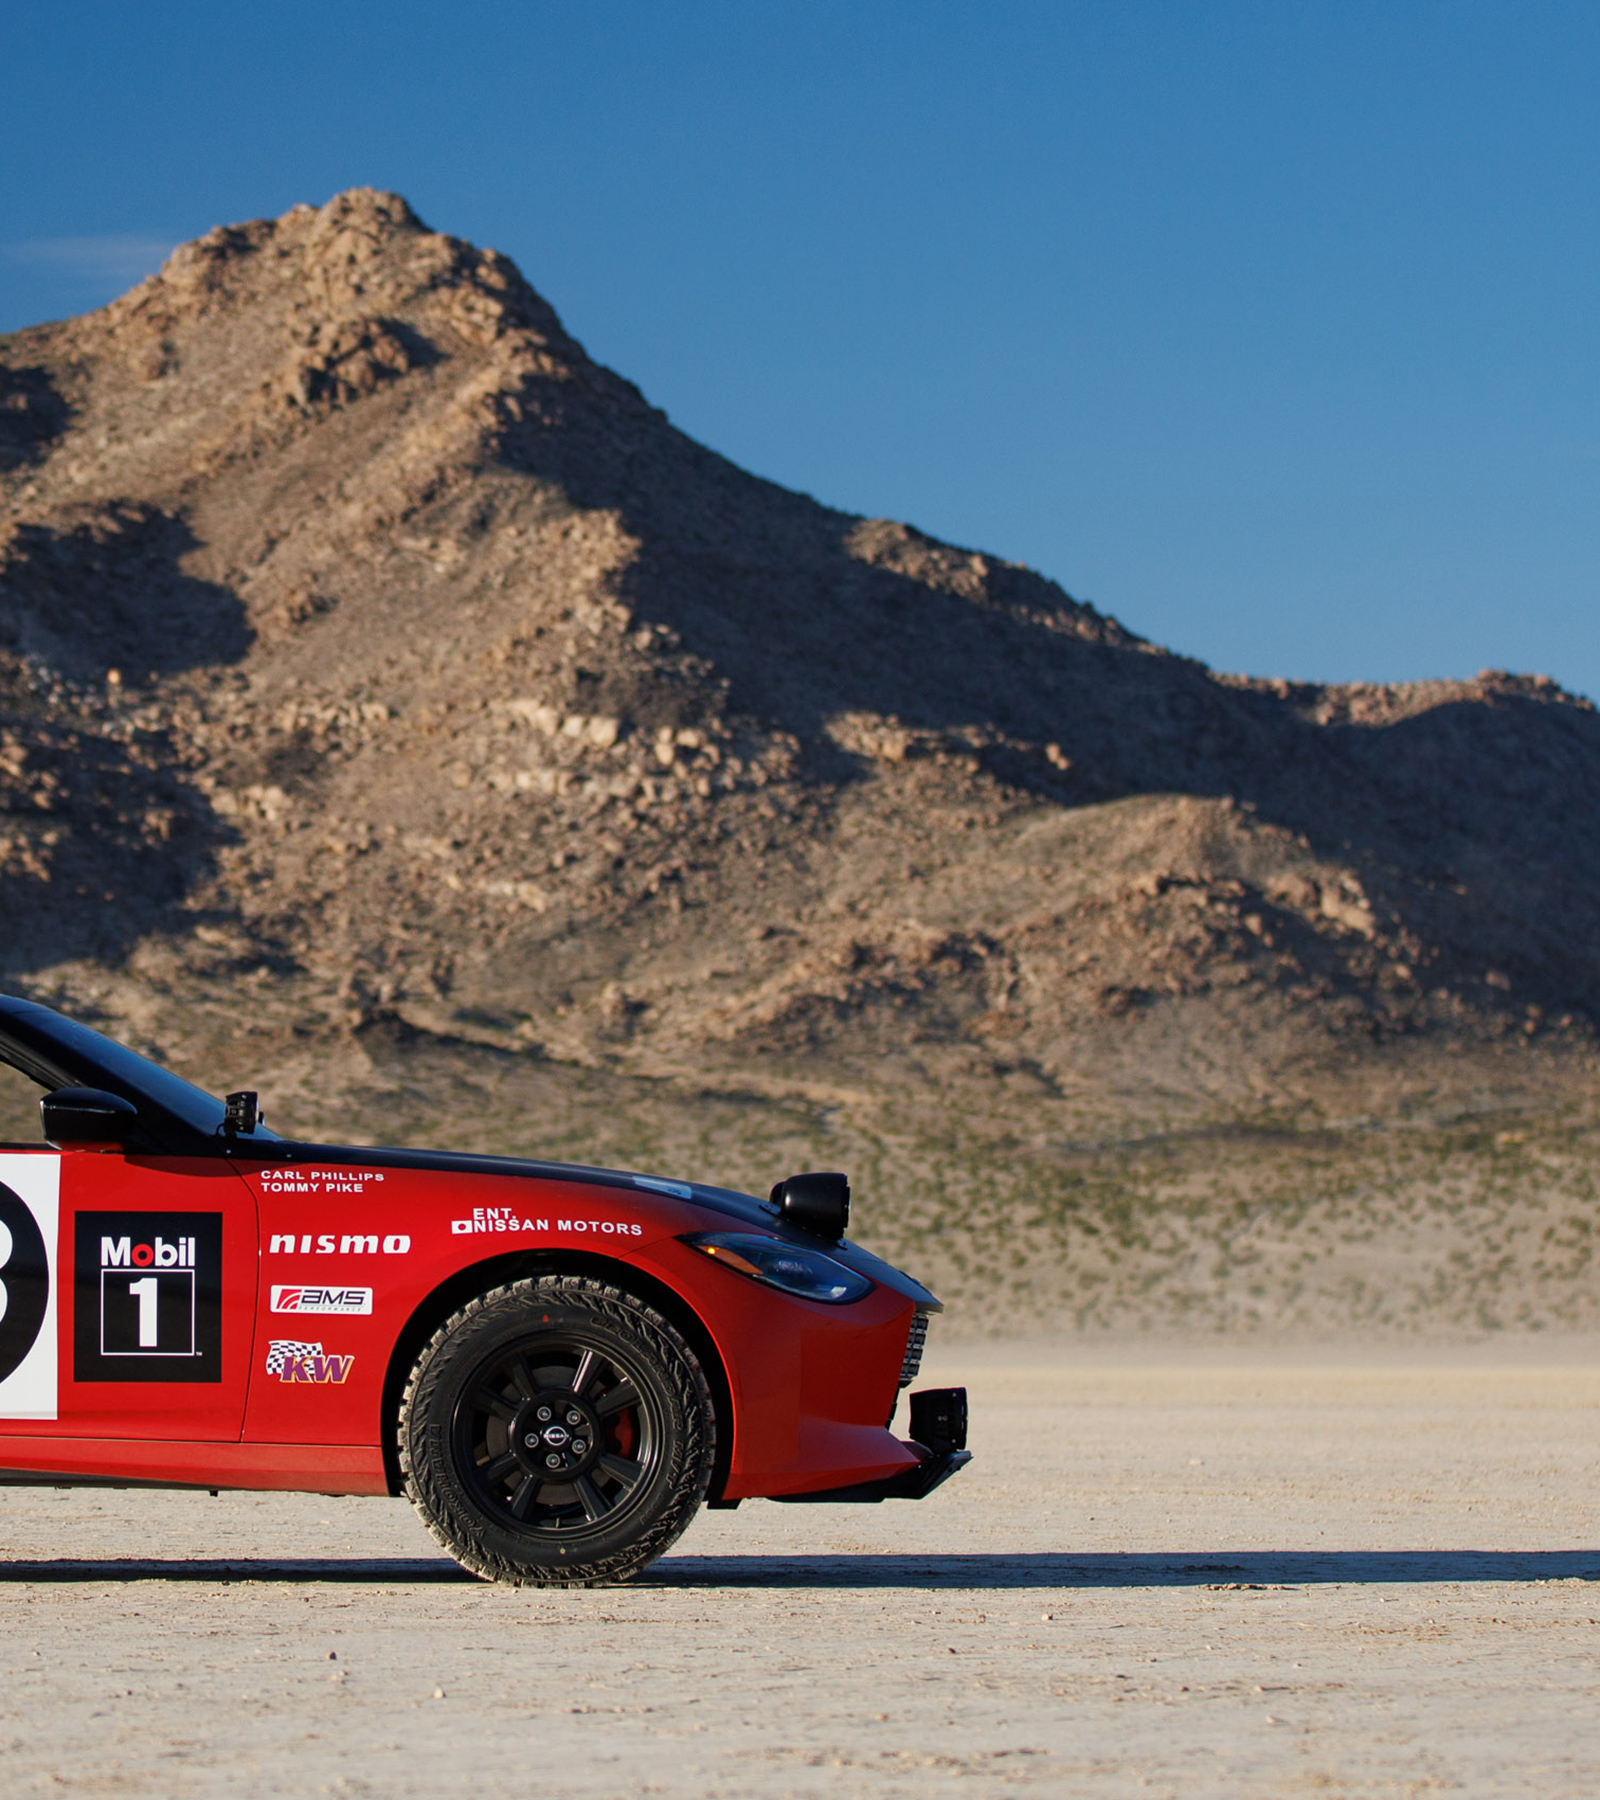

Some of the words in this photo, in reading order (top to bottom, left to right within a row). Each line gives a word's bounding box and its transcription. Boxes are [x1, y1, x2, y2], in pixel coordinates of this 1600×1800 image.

[260, 1170, 305, 1180] CARL
[311, 1171, 385, 1182] PHILLIPS
[261, 1182, 320, 1193] TOMMY
[325, 1183, 364, 1193] PIKE
[473, 1207, 517, 1220] ENT.
[473, 1219, 550, 1233] NISSAN
[557, 1219, 643, 1237] MOTORS
[101, 1236, 196, 1267] Mobil
[269, 1234, 411, 1254] nismo
[129, 1277, 158, 1347] 1
[279, 1354, 356, 1384] KW
